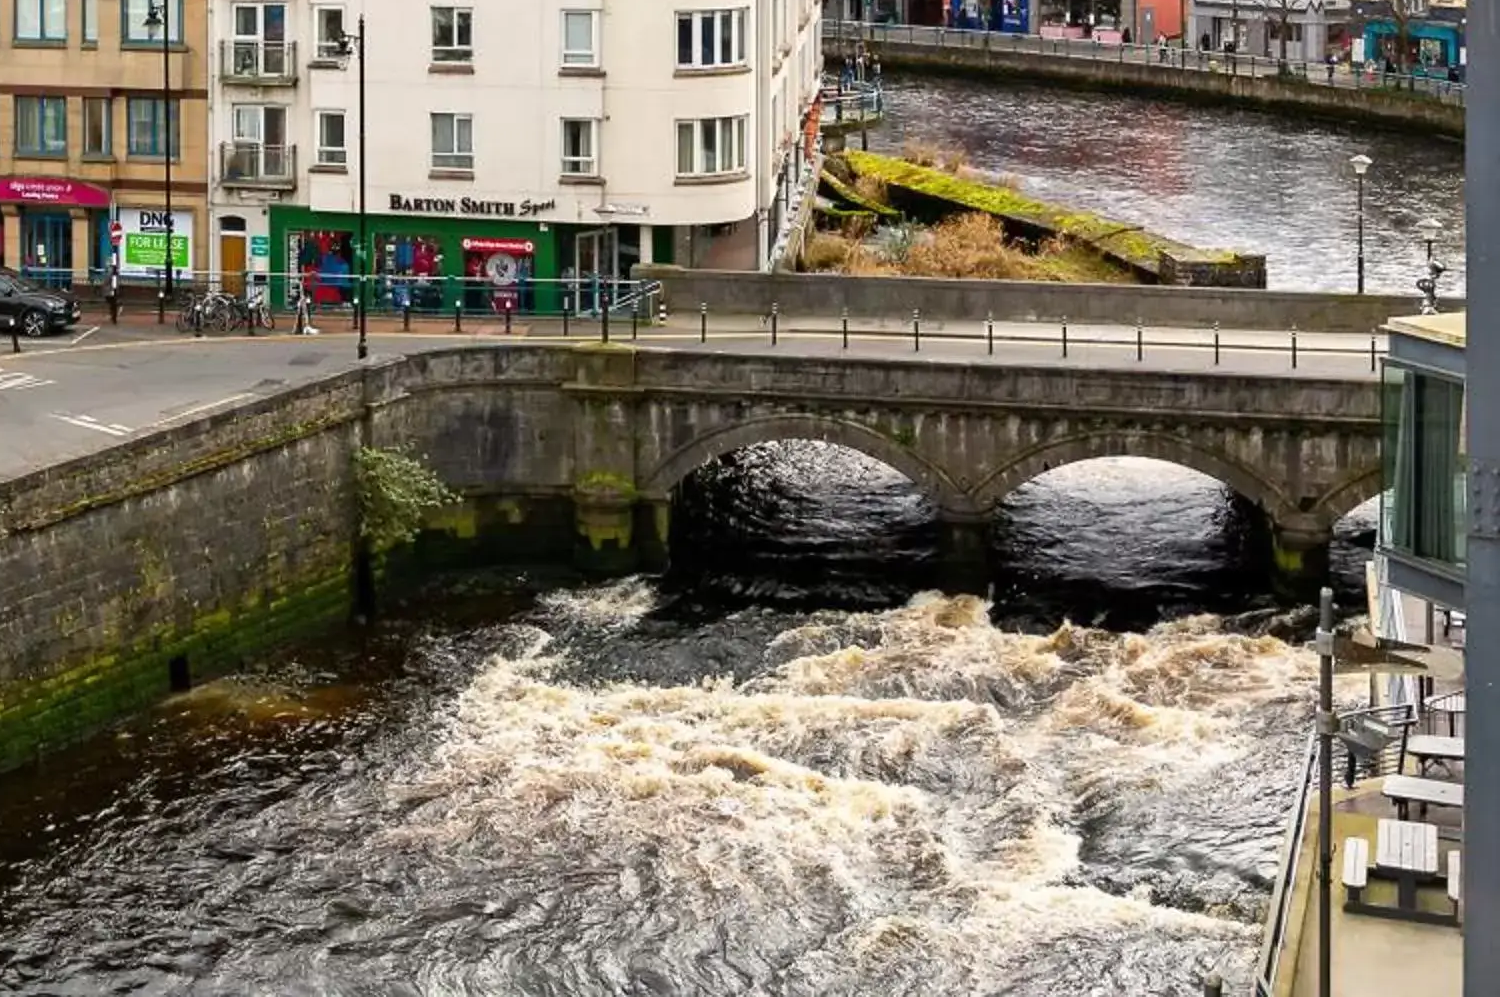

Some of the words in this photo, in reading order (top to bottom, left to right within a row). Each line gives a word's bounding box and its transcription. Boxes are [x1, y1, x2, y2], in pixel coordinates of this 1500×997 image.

[389, 193, 456, 212] BARTON
[460, 196, 515, 216] SMITH
[129, 235, 151, 249] FOR
